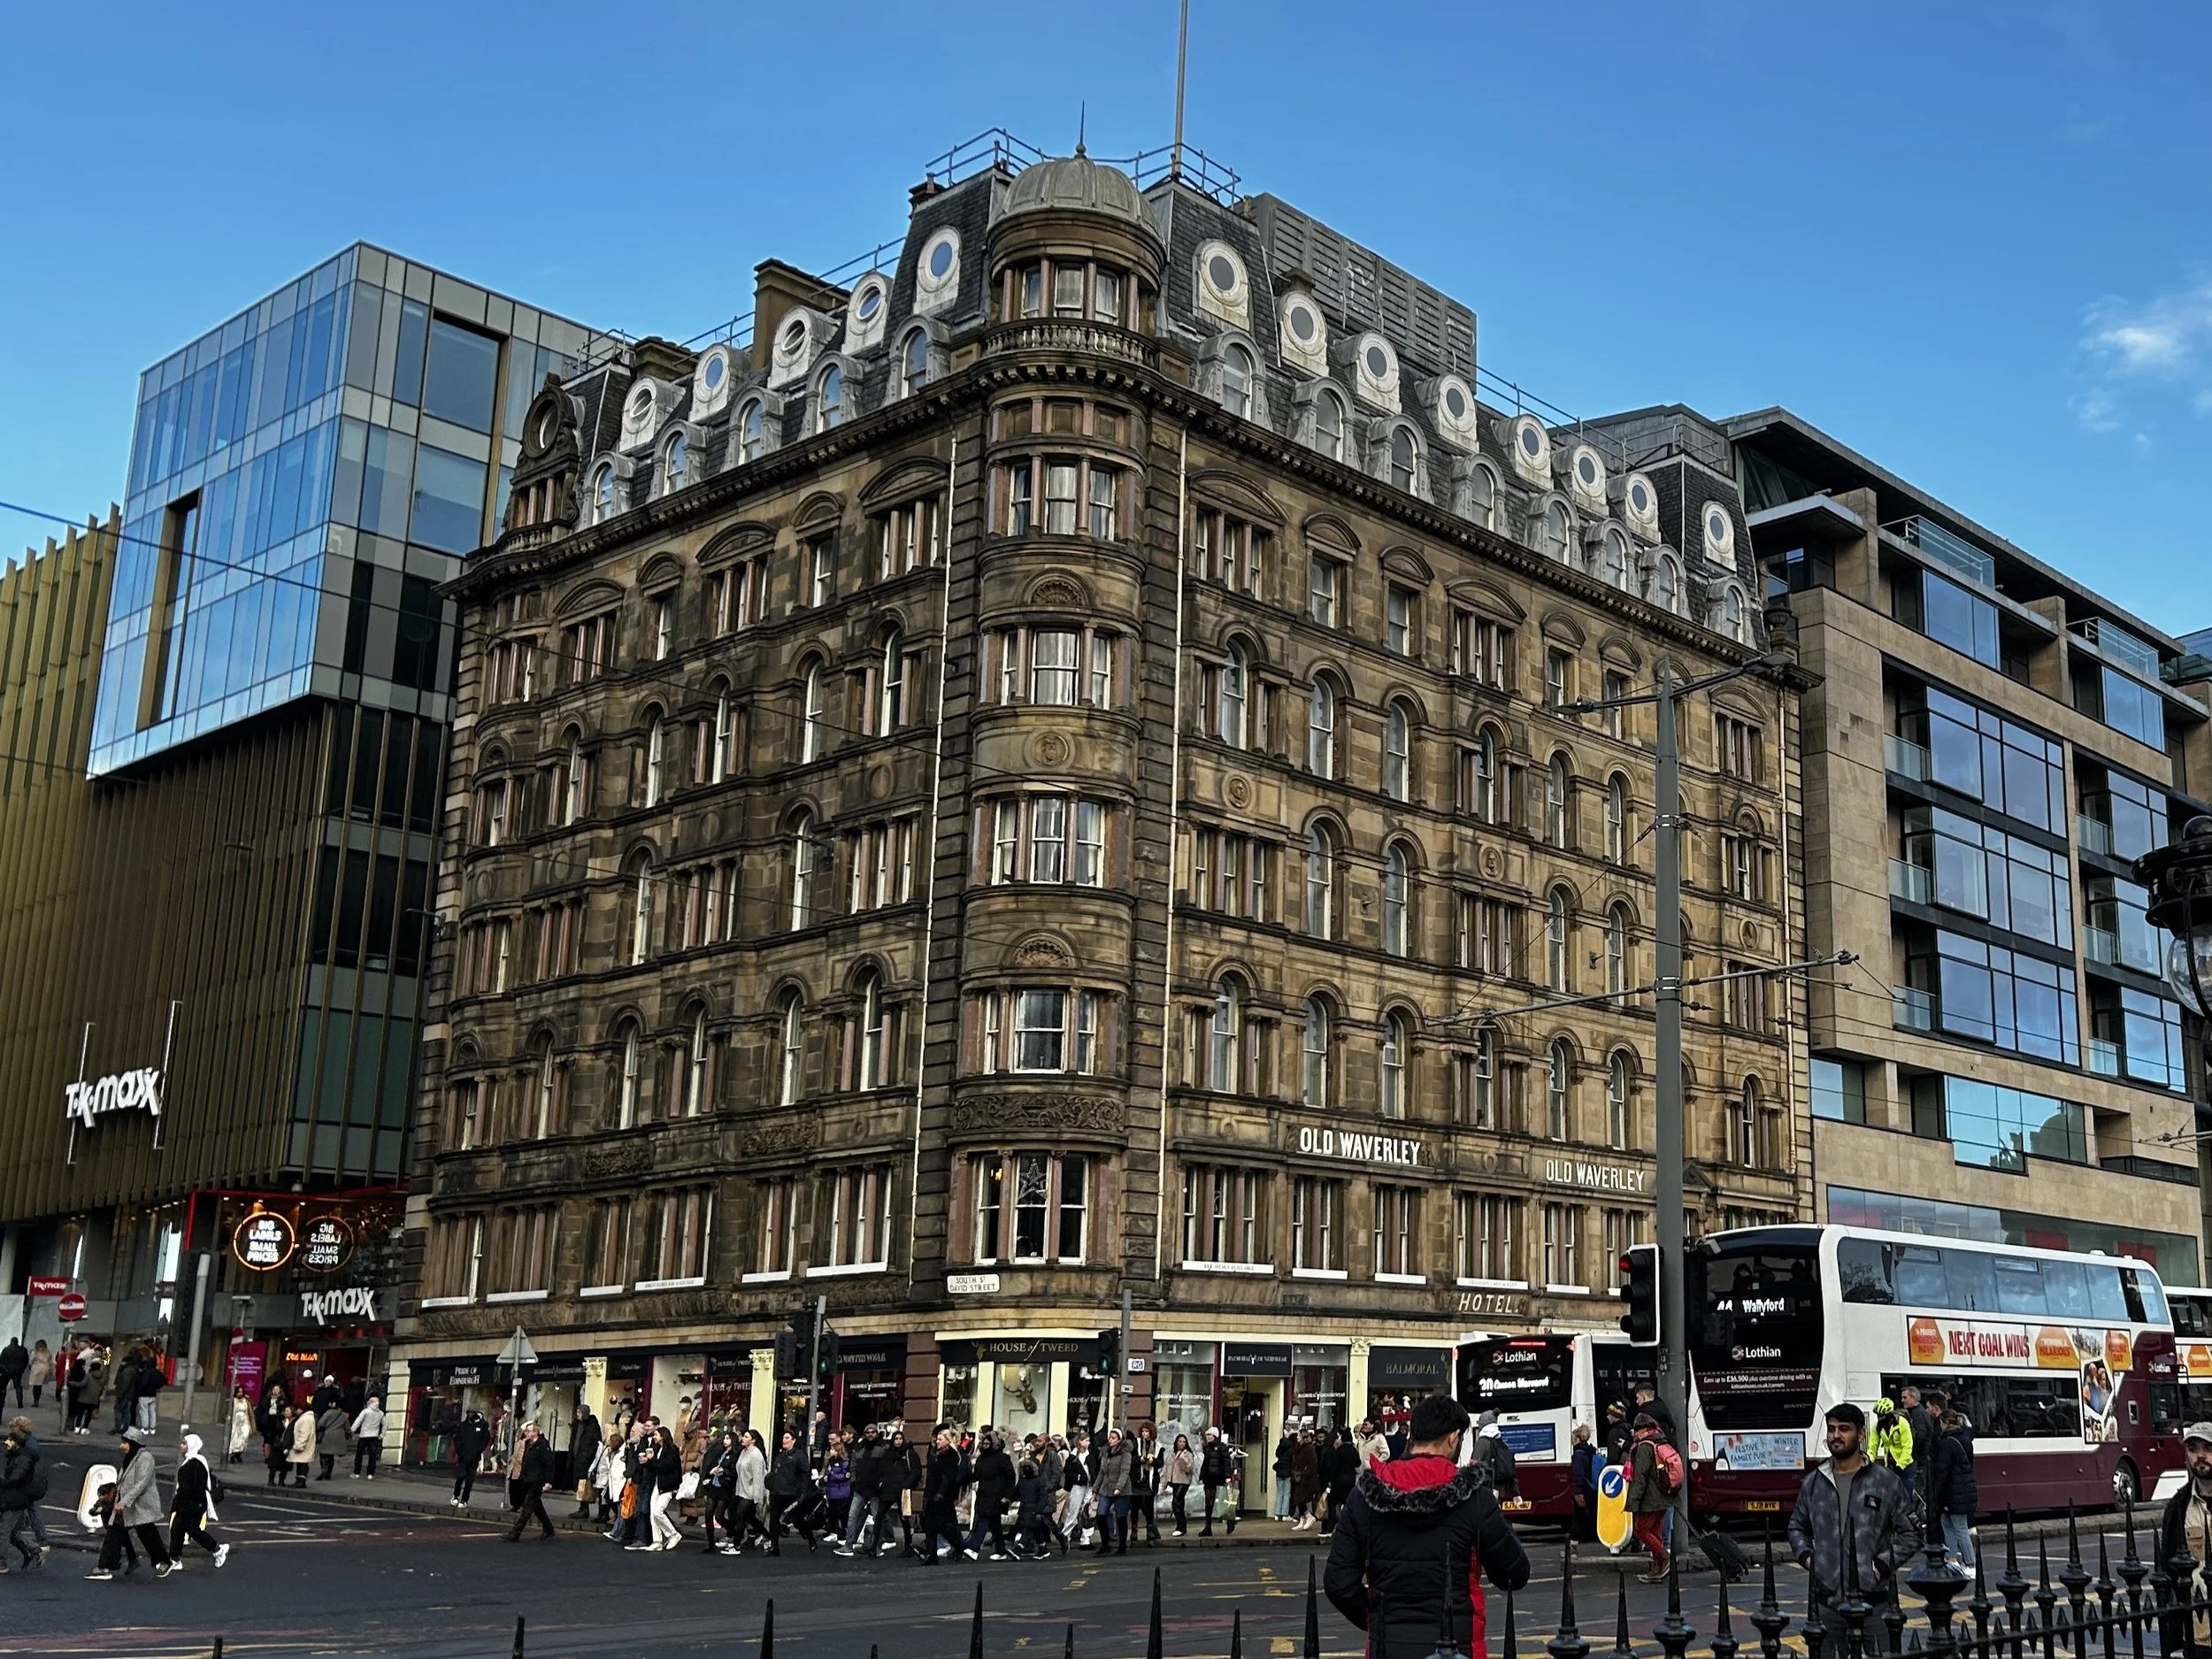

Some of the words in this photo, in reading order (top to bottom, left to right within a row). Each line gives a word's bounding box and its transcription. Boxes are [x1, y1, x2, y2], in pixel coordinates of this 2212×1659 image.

[1300, 1127, 1333, 1155] OLD
[1340, 1132, 1420, 1165] WAVERLEY
[1546, 1159, 1572, 1183] OLD
[1576, 1162, 1645, 1192] WAVERLEY
[249, 1229, 282, 1240] LABELS
[250, 1241, 278, 1252] SMALL
[247, 1251, 279, 1263] PRICES
[970, 1283, 996, 1292] STREET
[1948, 1330, 1976, 1356] NEXT
[1978, 1332, 2004, 1357] GOAL
[2004, 1333, 2031, 1358] WINS
[989, 1341, 1026, 1353] HOUSE
[1023, 1339, 1043, 1362] of
[1041, 1342, 1079, 1353] TWEED
[1504, 1350, 1537, 1363] Lothian
[1745, 1346, 1782, 1358] Lothian
[1386, 1363, 1439, 1375] BALMORAL
[449, 1374, 480, 1386] EDINBURGH
[1774, 1436, 1799, 1446] WINTER
[1735, 1443, 1760, 1453] FESTIVE
[1731, 1452, 1752, 1463] FAMILY
[1753, 1451, 1766, 1460] FUN
